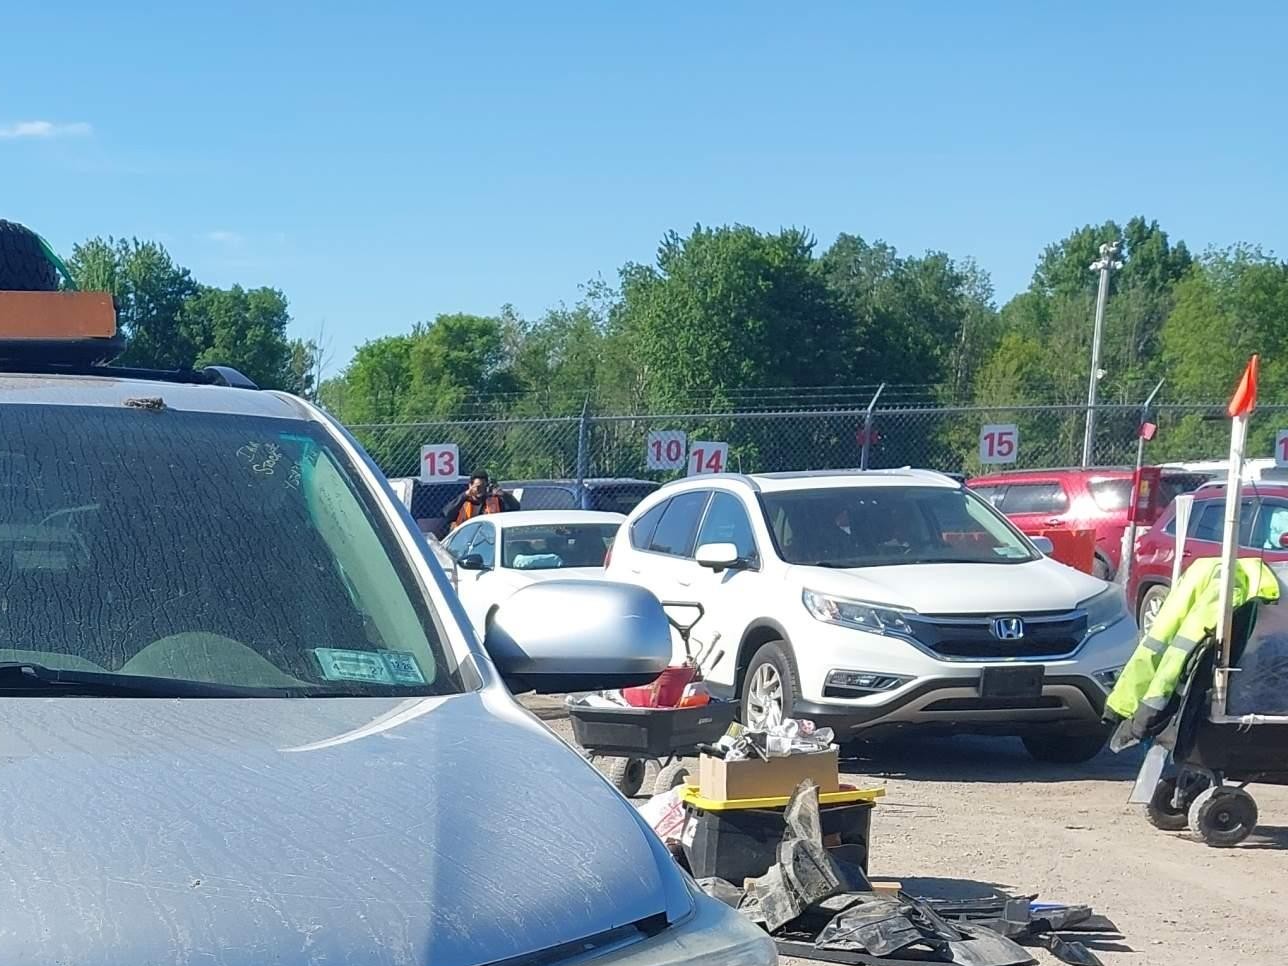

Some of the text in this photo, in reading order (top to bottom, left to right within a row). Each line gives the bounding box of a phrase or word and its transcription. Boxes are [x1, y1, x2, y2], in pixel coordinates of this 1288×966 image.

[652, 439, 681, 462] 10
[983, 431, 1014, 457] 15
[1278, 436, 1288, 461] 1
[424, 451, 455, 476] 13
[692, 448, 723, 474] 14
